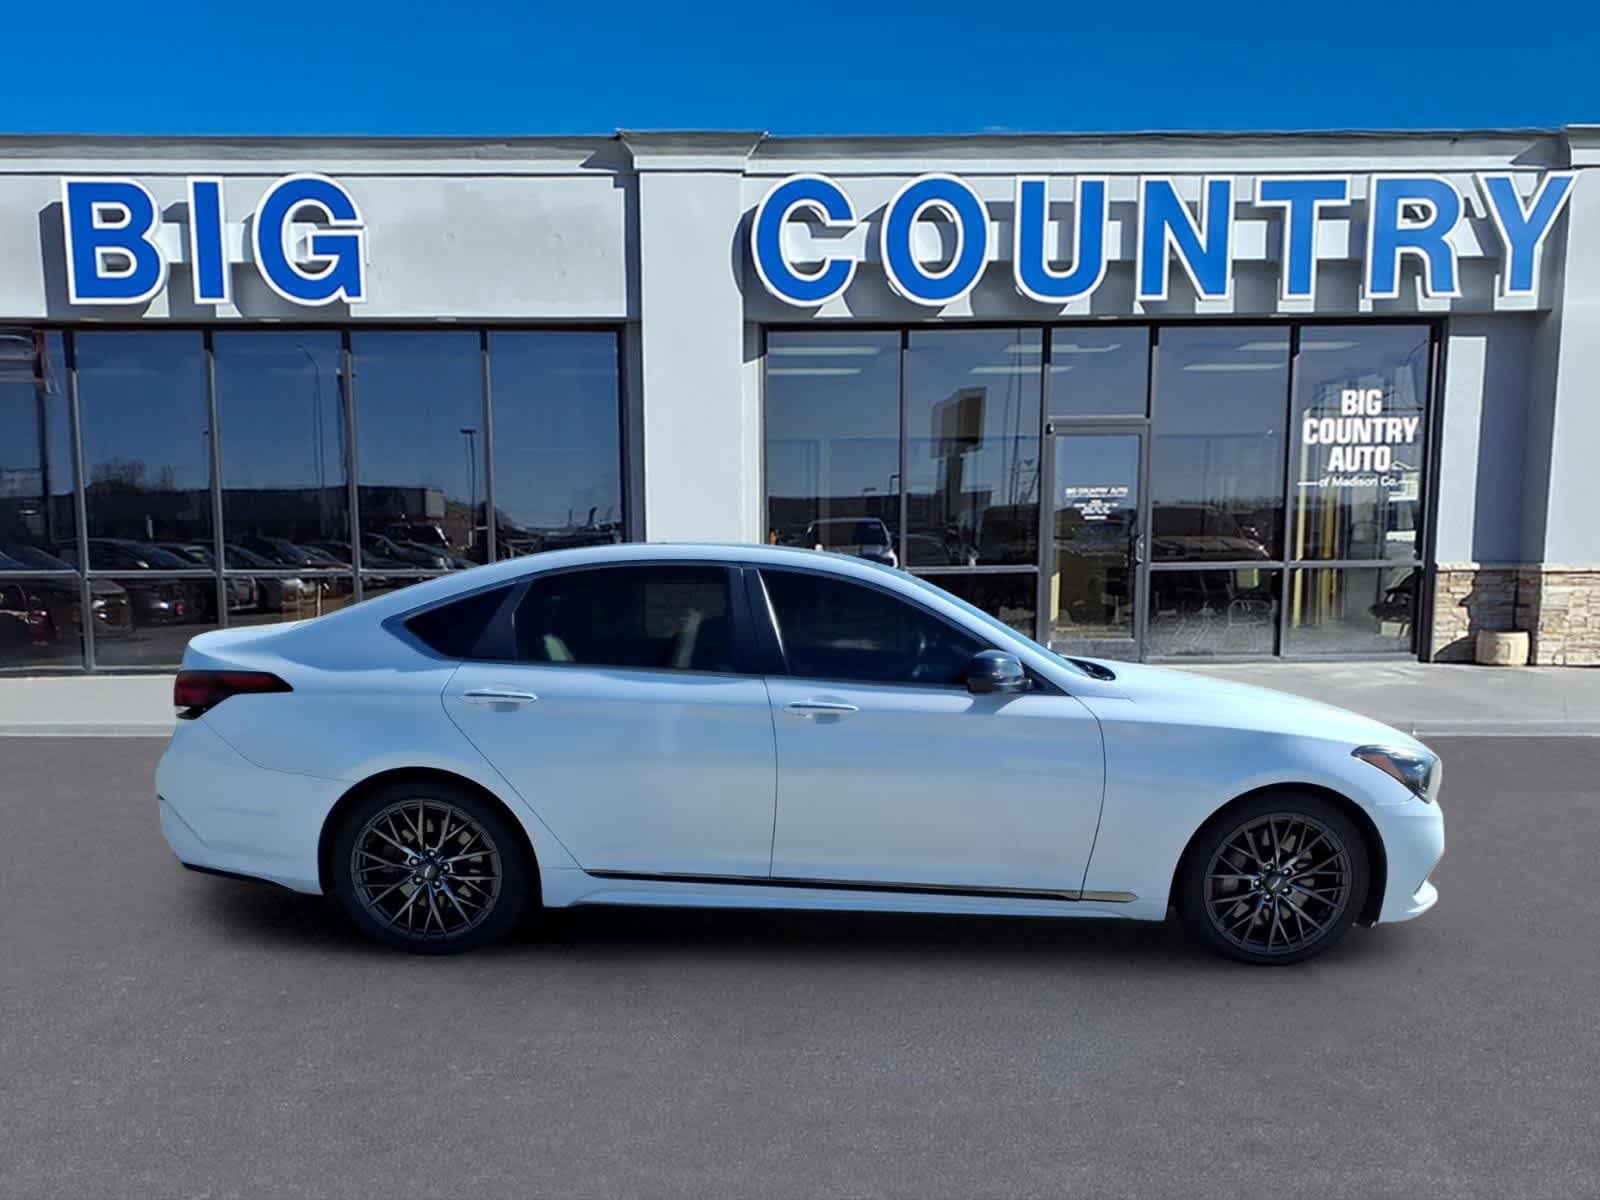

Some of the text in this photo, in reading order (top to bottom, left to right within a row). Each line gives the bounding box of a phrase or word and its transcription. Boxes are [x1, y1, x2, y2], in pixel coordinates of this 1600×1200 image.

[60, 172, 1576, 306] BIG COUNTRY
[1341, 389, 1382, 416] BIG
[1302, 417, 1419, 444] COUNTRY
[1327, 445, 1391, 472] AUTO
[1319, 475, 1331, 487] of
[1331, 475, 1378, 487] Madison
